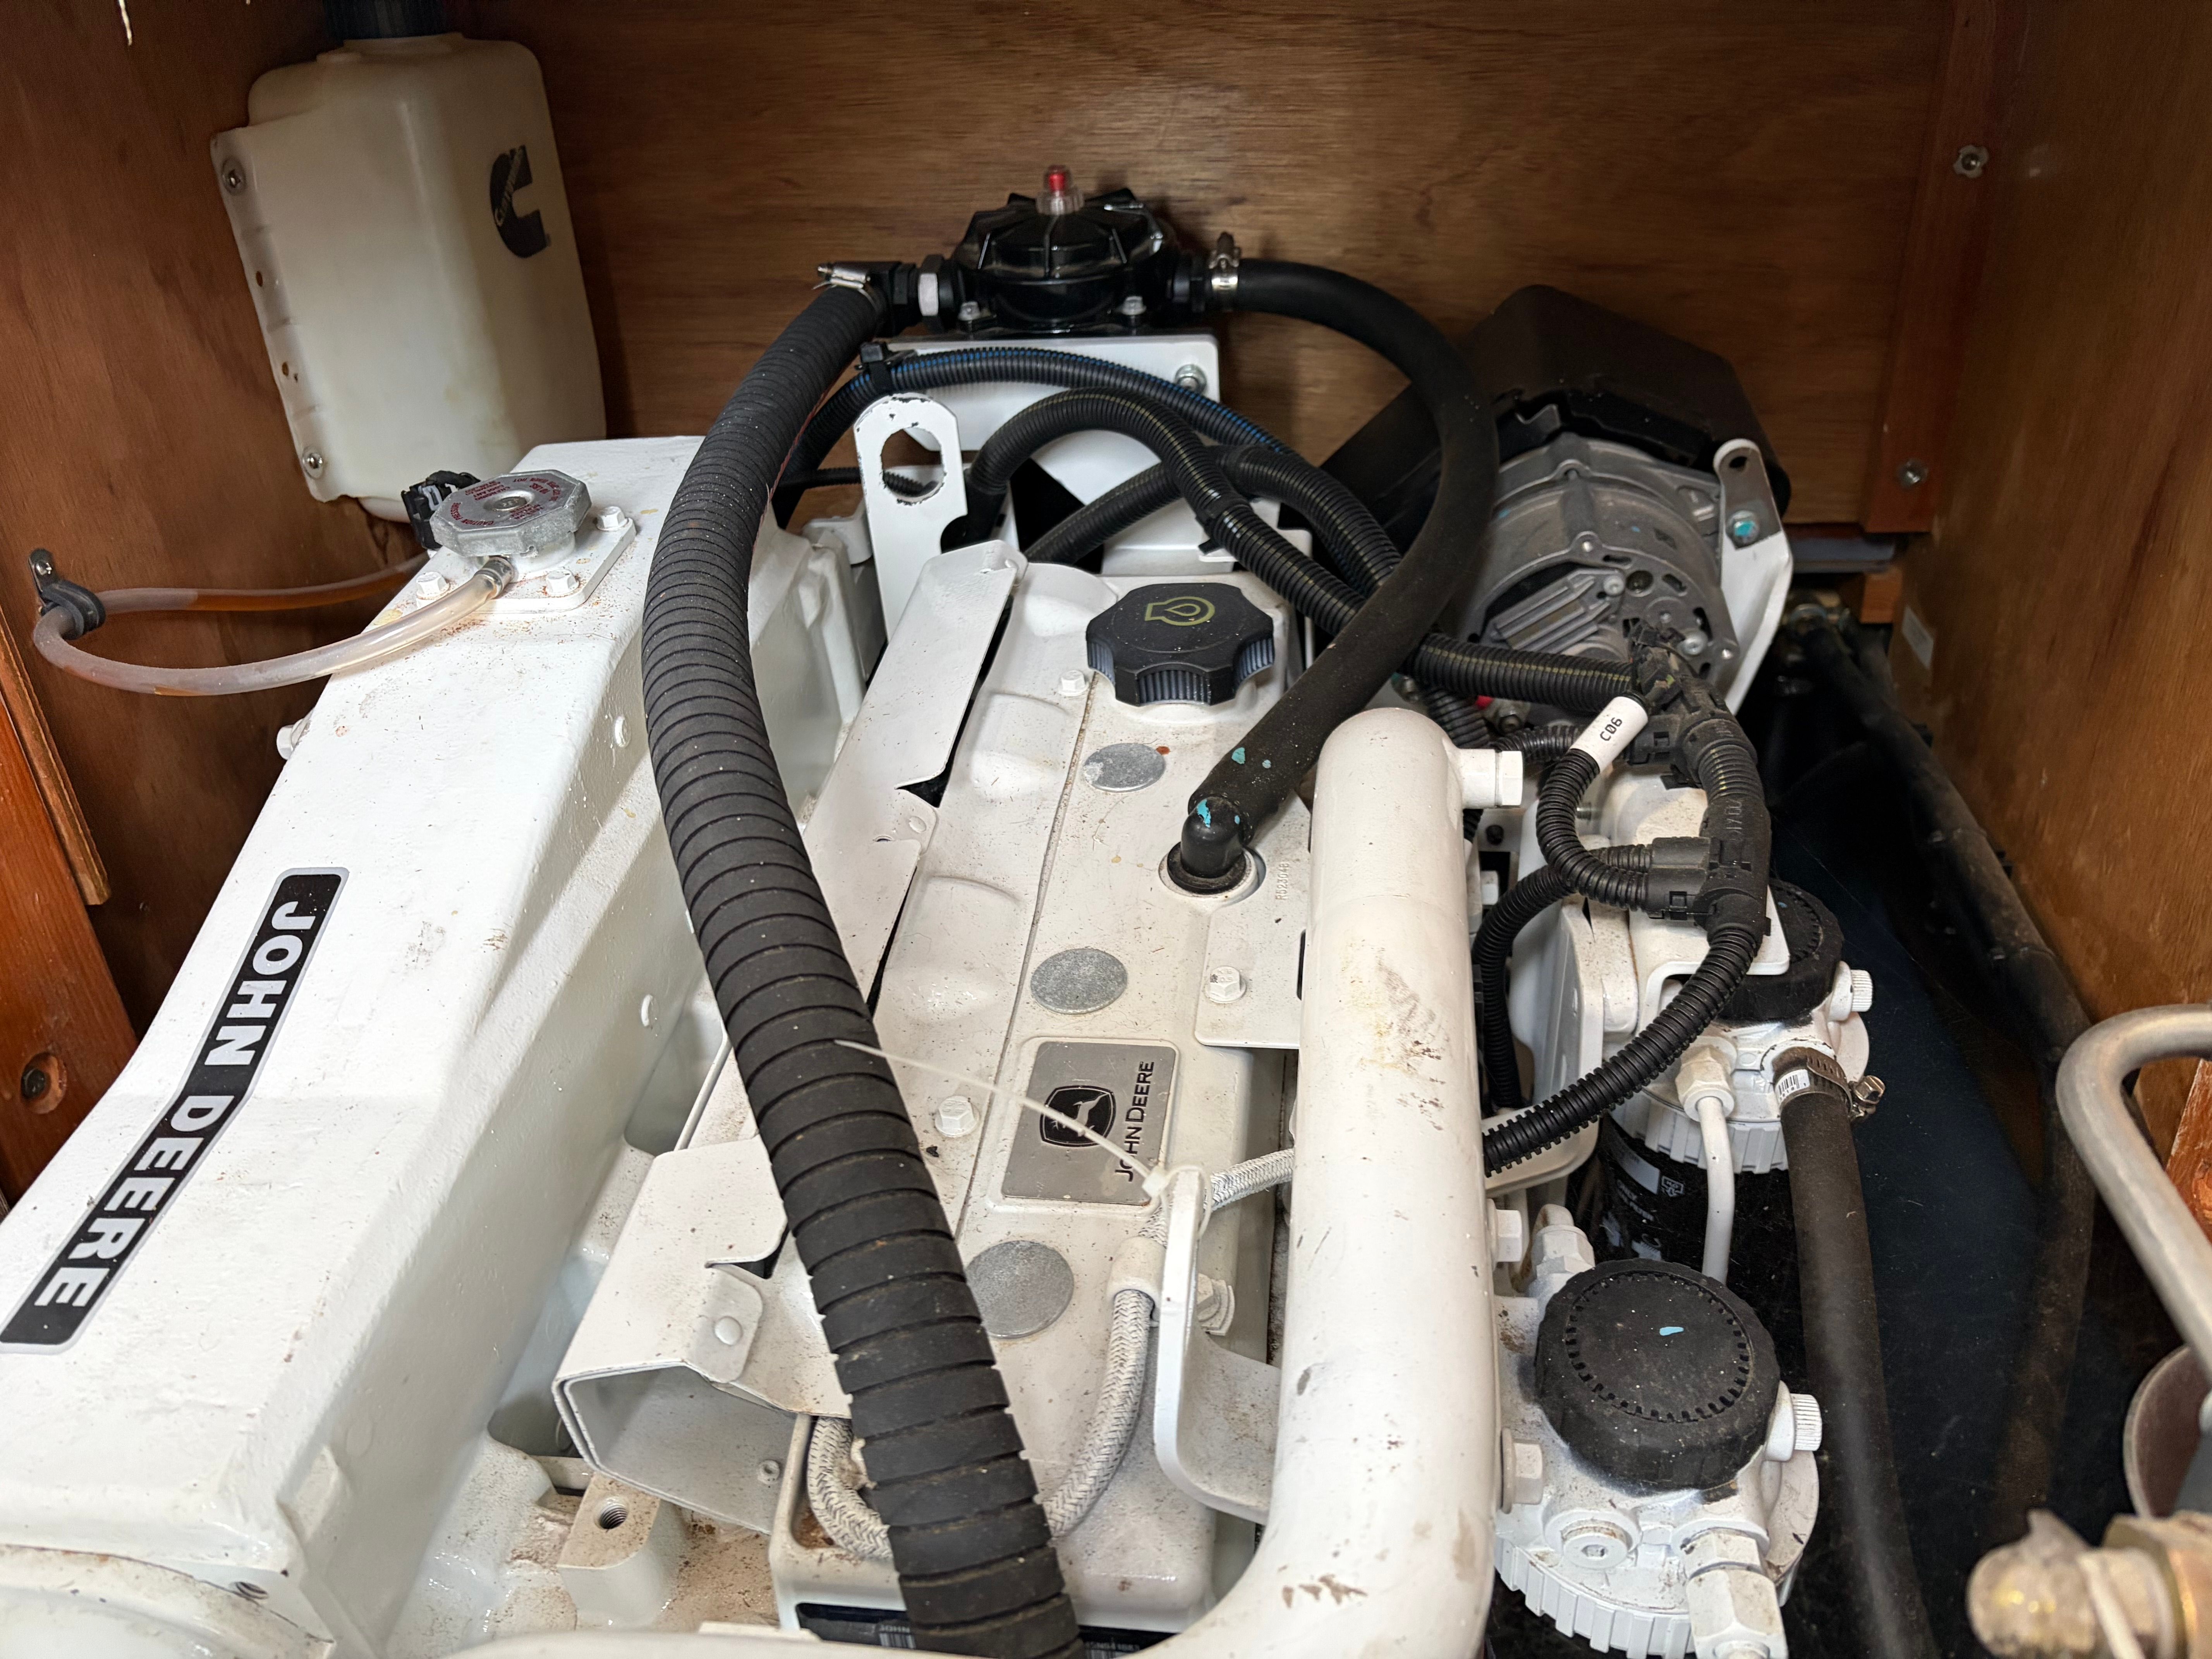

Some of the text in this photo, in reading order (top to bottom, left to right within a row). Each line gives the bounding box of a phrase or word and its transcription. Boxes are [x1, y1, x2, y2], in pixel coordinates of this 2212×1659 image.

[1599, 717, 1623, 741] C06
[34, 901, 316, 1306] JOHN DEERE
[1125, 1061, 1154, 1122] DEERE
